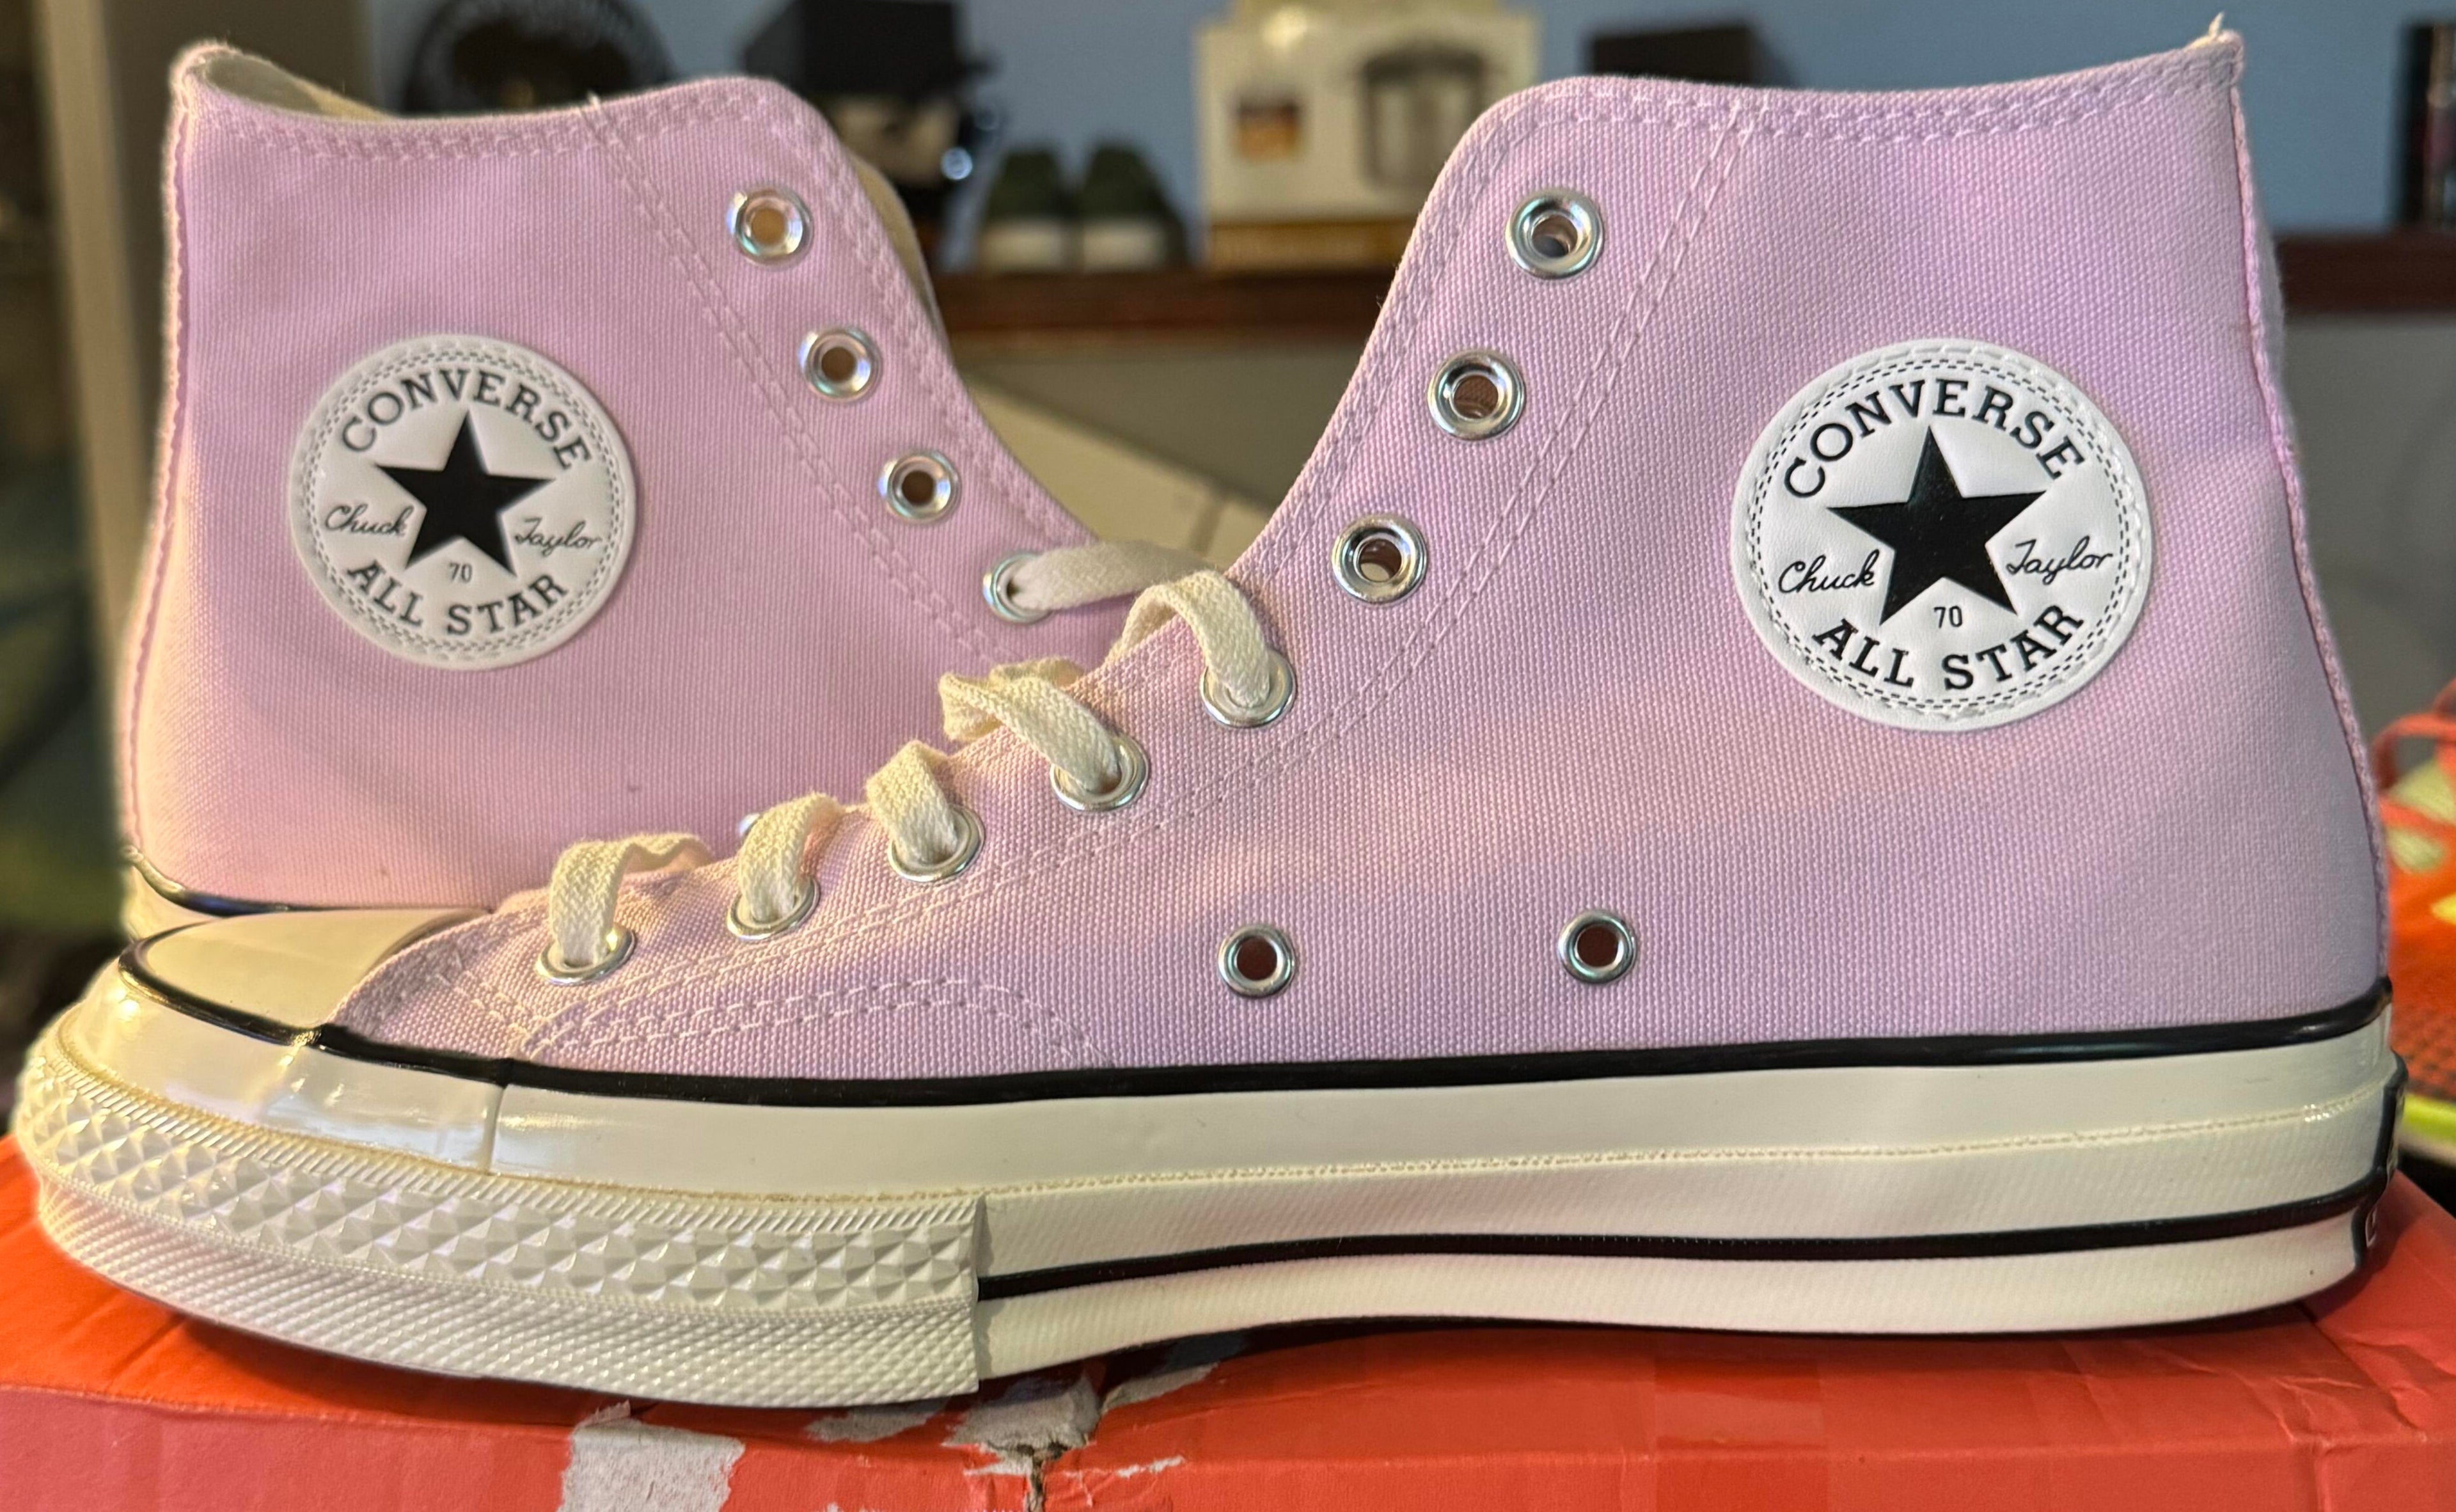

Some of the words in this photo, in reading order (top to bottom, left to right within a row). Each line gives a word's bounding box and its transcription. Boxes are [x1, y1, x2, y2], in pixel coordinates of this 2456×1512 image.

[342, 368, 592, 470] CONVERSE
[1784, 378, 2085, 498] CONVERSE
[325, 503, 414, 537] Chuck
[514, 517, 604, 557] Taylor
[448, 563, 473, 583] 70
[1778, 549, 1881, 593] Chuck
[2006, 535, 2114, 583] Taylor
[347, 560, 423, 627] ALL
[447, 574, 569, 636] STAR
[1933, 605, 1964, 628] 70
[1811, 618, 1915, 688] ALL
[1941, 604, 2084, 691] STAR
